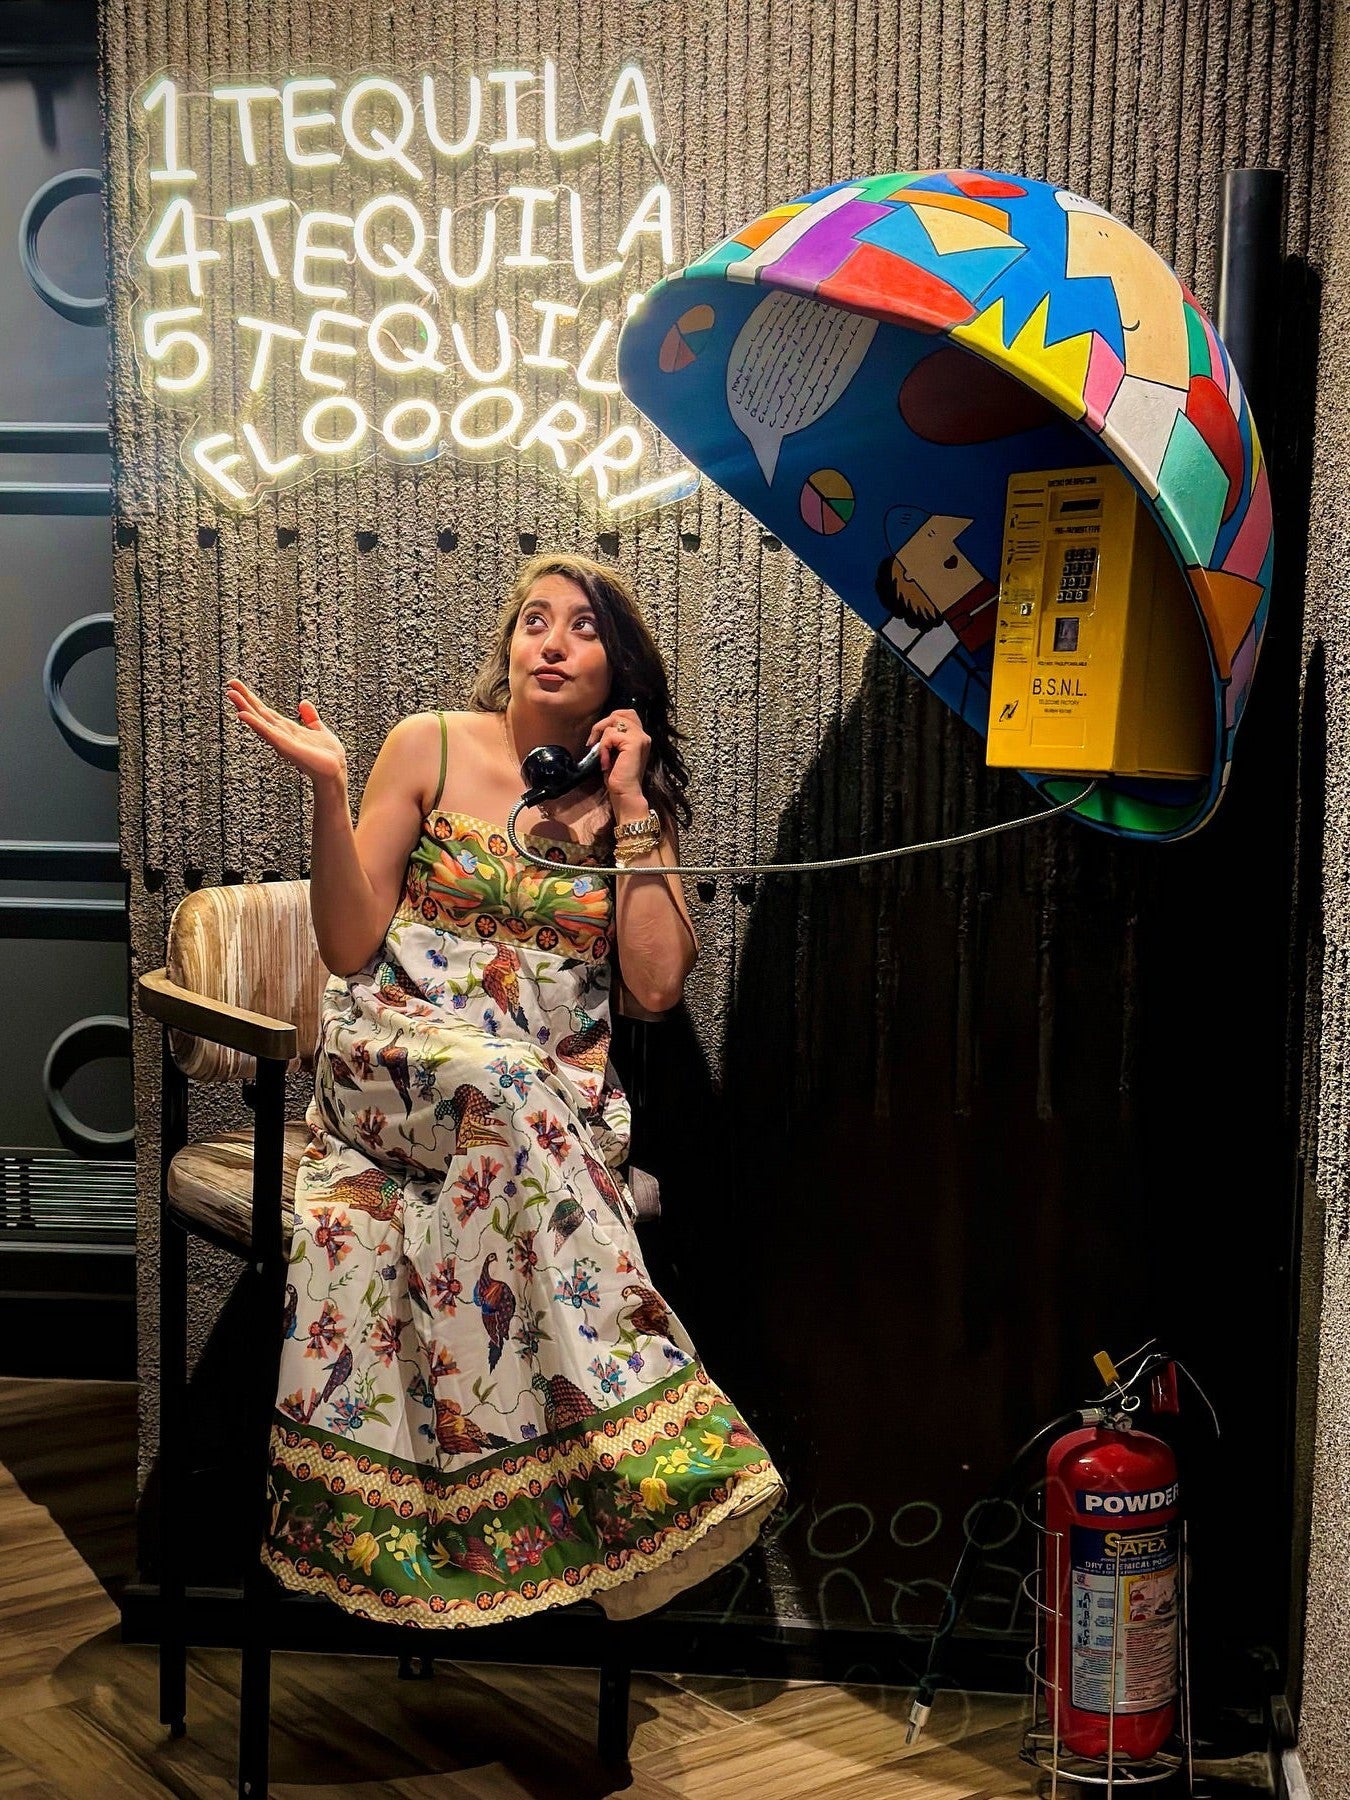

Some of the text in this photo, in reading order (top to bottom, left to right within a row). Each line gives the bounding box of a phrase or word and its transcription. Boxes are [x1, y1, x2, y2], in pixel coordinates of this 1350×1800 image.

[144, 59, 657, 181] 1 TEQUILA
[144, 184, 675, 298] 4 TEQUILA
[143, 307, 211, 390] 5
[238, 293, 646, 391] TEQUIL
[1032, 678, 1087, 697] B.S.N.L.
